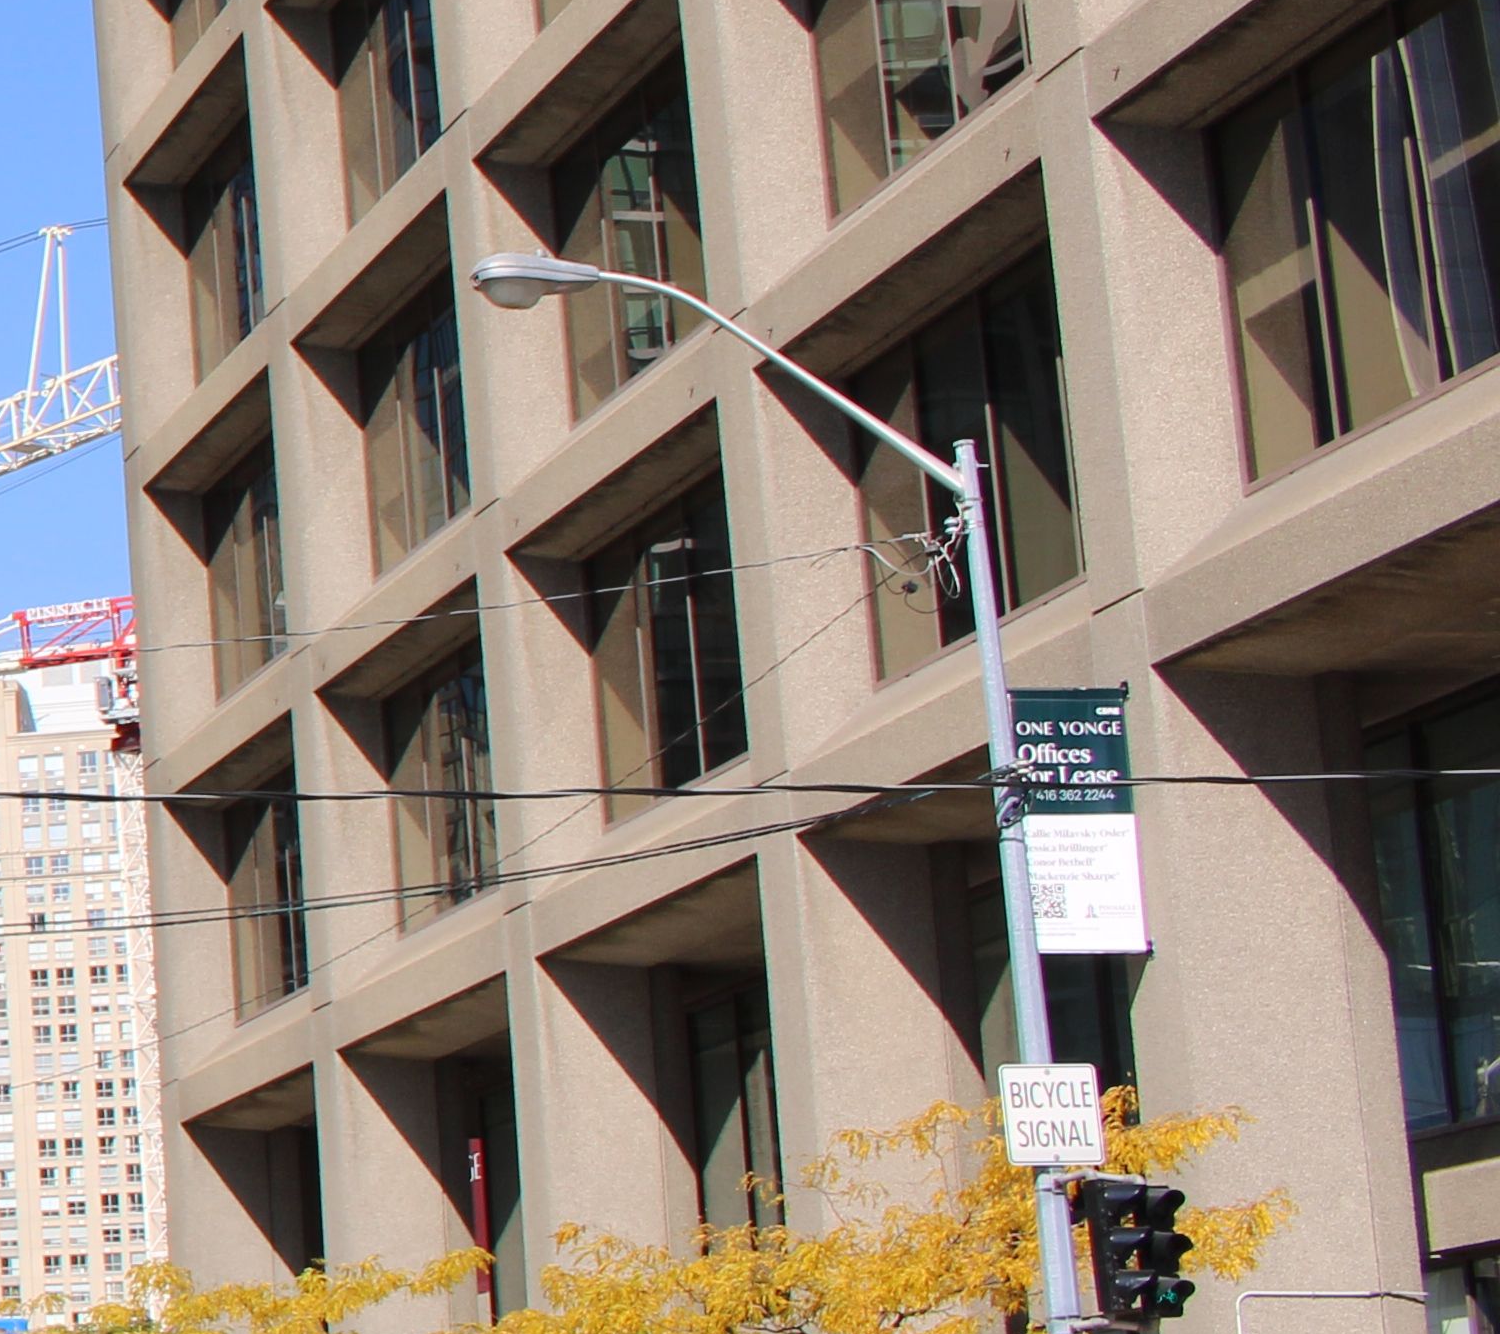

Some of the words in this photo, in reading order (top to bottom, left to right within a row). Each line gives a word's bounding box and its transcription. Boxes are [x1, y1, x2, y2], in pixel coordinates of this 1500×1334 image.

[26, 598, 111, 620] PINNACLE
[1016, 720, 1055, 736] ONE
[1058, 720, 1122, 736] YONGE
[1018, 742, 1092, 764] Offices
[1059, 766, 1119, 784] Lease
[1036, 789, 1057, 801] 416
[1059, 789, 1082, 801] 362
[1084, 789, 1116, 801] 2244
[1010, 1081, 1092, 1108] BICYCLE
[1017, 1120, 1094, 1147] SIGNAL
